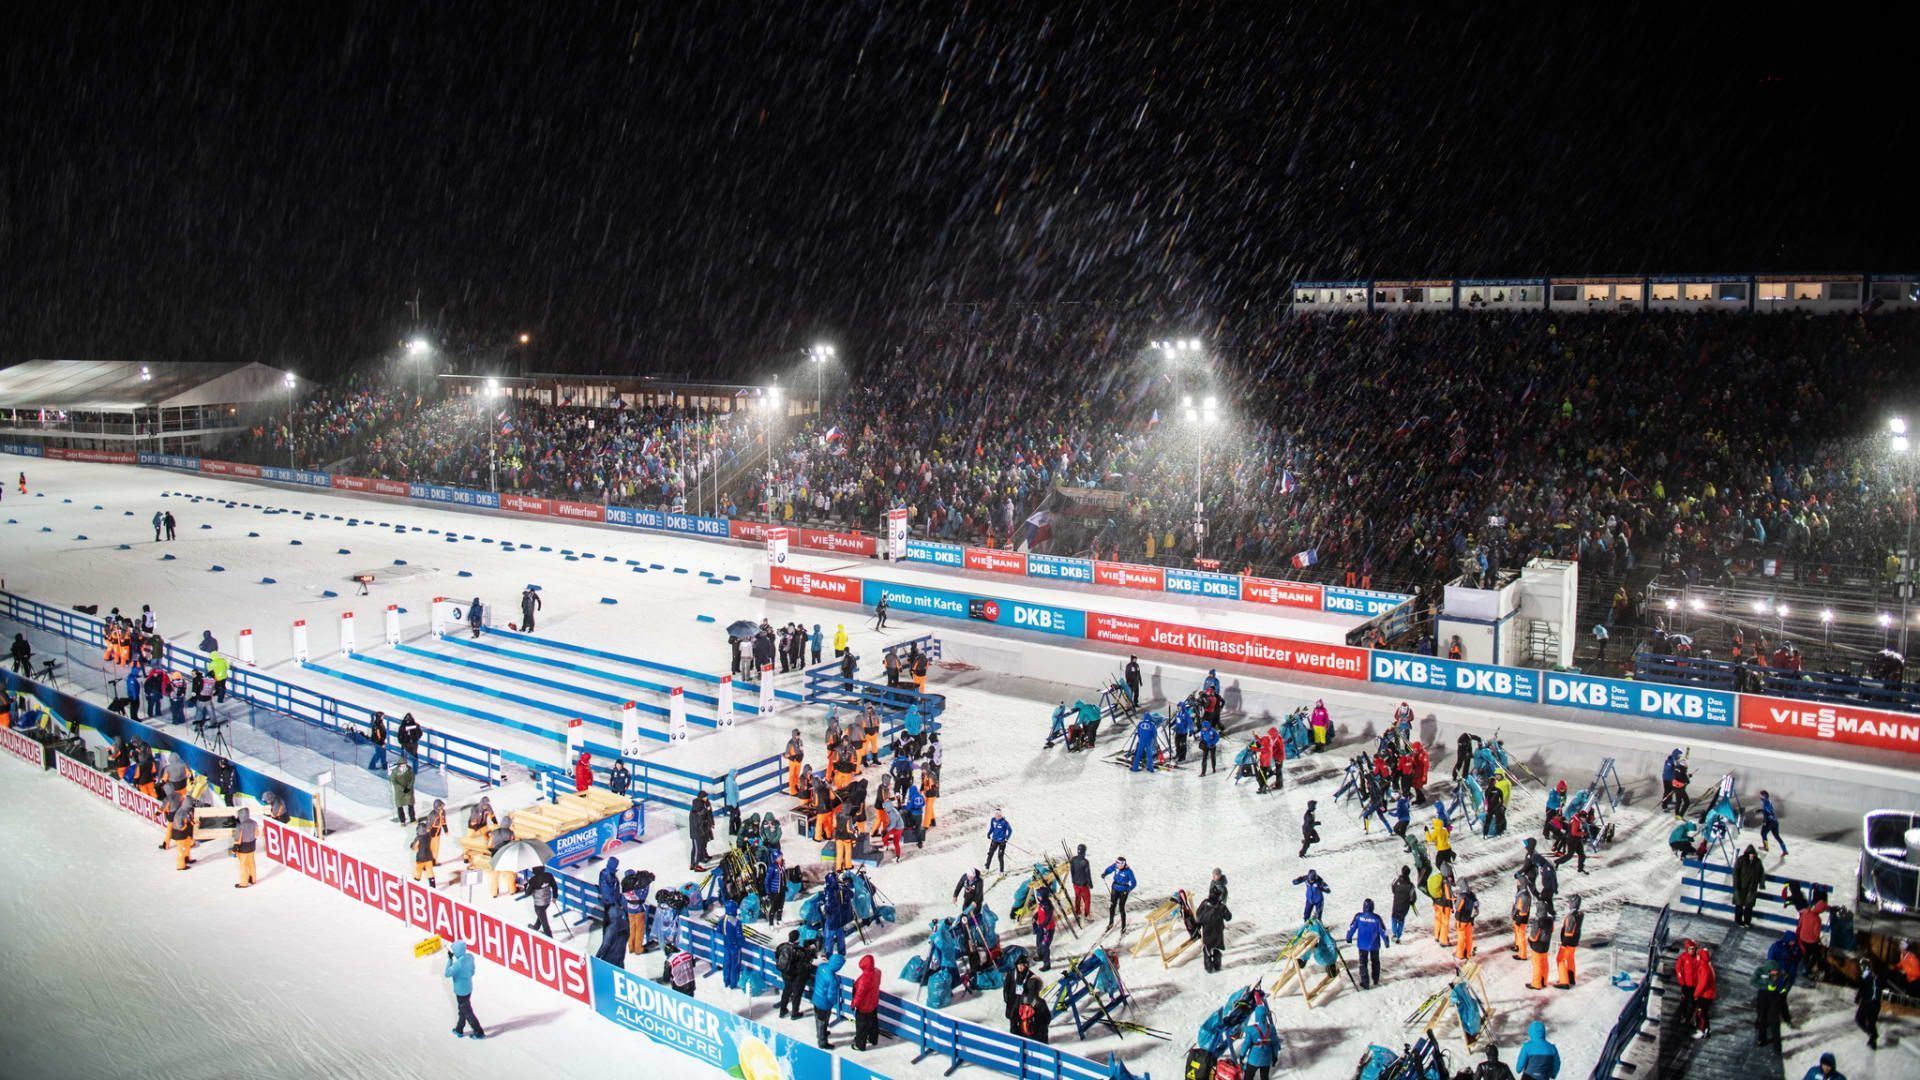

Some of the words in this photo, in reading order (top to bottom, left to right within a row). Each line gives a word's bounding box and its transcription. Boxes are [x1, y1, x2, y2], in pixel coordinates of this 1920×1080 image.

[410, 486, 425, 498] DKB
[430, 488, 447, 500] DKB
[453, 490, 470, 503] DKB
[476, 493, 492, 506] DKB
[506, 497, 542, 511] VIESSMANN
[559, 505, 598, 519] #Winterfans
[607, 509, 627, 523] DKB
[636, 512, 656, 527] DKB
[667, 515, 688, 530] DKB
[697, 518, 720, 534] DKB
[739, 525, 768, 541] VIESSM
[810, 533, 864, 550] VIESSMANN
[906, 547, 926, 560] DKB
[934, 550, 954, 564] DKB
[970, 555, 1021, 570] VIESSMANN
[1029, 561, 1051, 575] DKB
[1060, 564, 1083, 579] DKB
[1100, 569, 1157, 585] VIESSMANN
[783, 573, 847, 593] VIESSMANN
[1167, 577, 1192, 591] DKB
[1203, 580, 1229, 596] DKB
[881, 588, 912, 606] Konto
[914, 595, 932, 608] mit
[933, 598, 963, 613] Karte
[1249, 586, 1314, 604] VIESSMANN
[1326, 595, 1354, 609] DKB
[985, 606, 997, 616] 0€
[1013, 605, 1052, 628] DKB
[1097, 617, 1140, 630] VIESSMANN
[1097, 629, 1140, 643] #Winterfans
[1150, 627, 1185, 647] Jetzt
[1187, 632, 1292, 663] Klimaschützer
[1294, 651, 1362, 673] werden!
[1375, 656, 1429, 684] DKB
[1456, 666, 1513, 695] DKB
[1515, 688, 1533, 698] Bank
[1548, 678, 1609, 706] DKB
[1640, 688, 1704, 718] DKB
[1610, 693, 1630, 702] kann
[1611, 685, 1627, 695] Das
[1610, 700, 1630, 710] Bank
[1706, 704, 1727, 715] kann
[1707, 696, 1724, 707] Das
[1706, 712, 1728, 723] Bank
[1770, 707, 1920, 742] VIESSMANN
[0, 730, 41, 764] AUHAUS
[60, 758, 113, 799] BAUHAUS
[119, 787, 168, 827] BAUH
[556, 827, 599, 850] ERDINGER
[266, 826, 402, 913] BAUHAUS
[411, 889, 586, 994] BAUHAUS
[612, 970, 724, 1047] ERDINGER
[616, 1006, 722, 1061] ALKOHOLFREI
